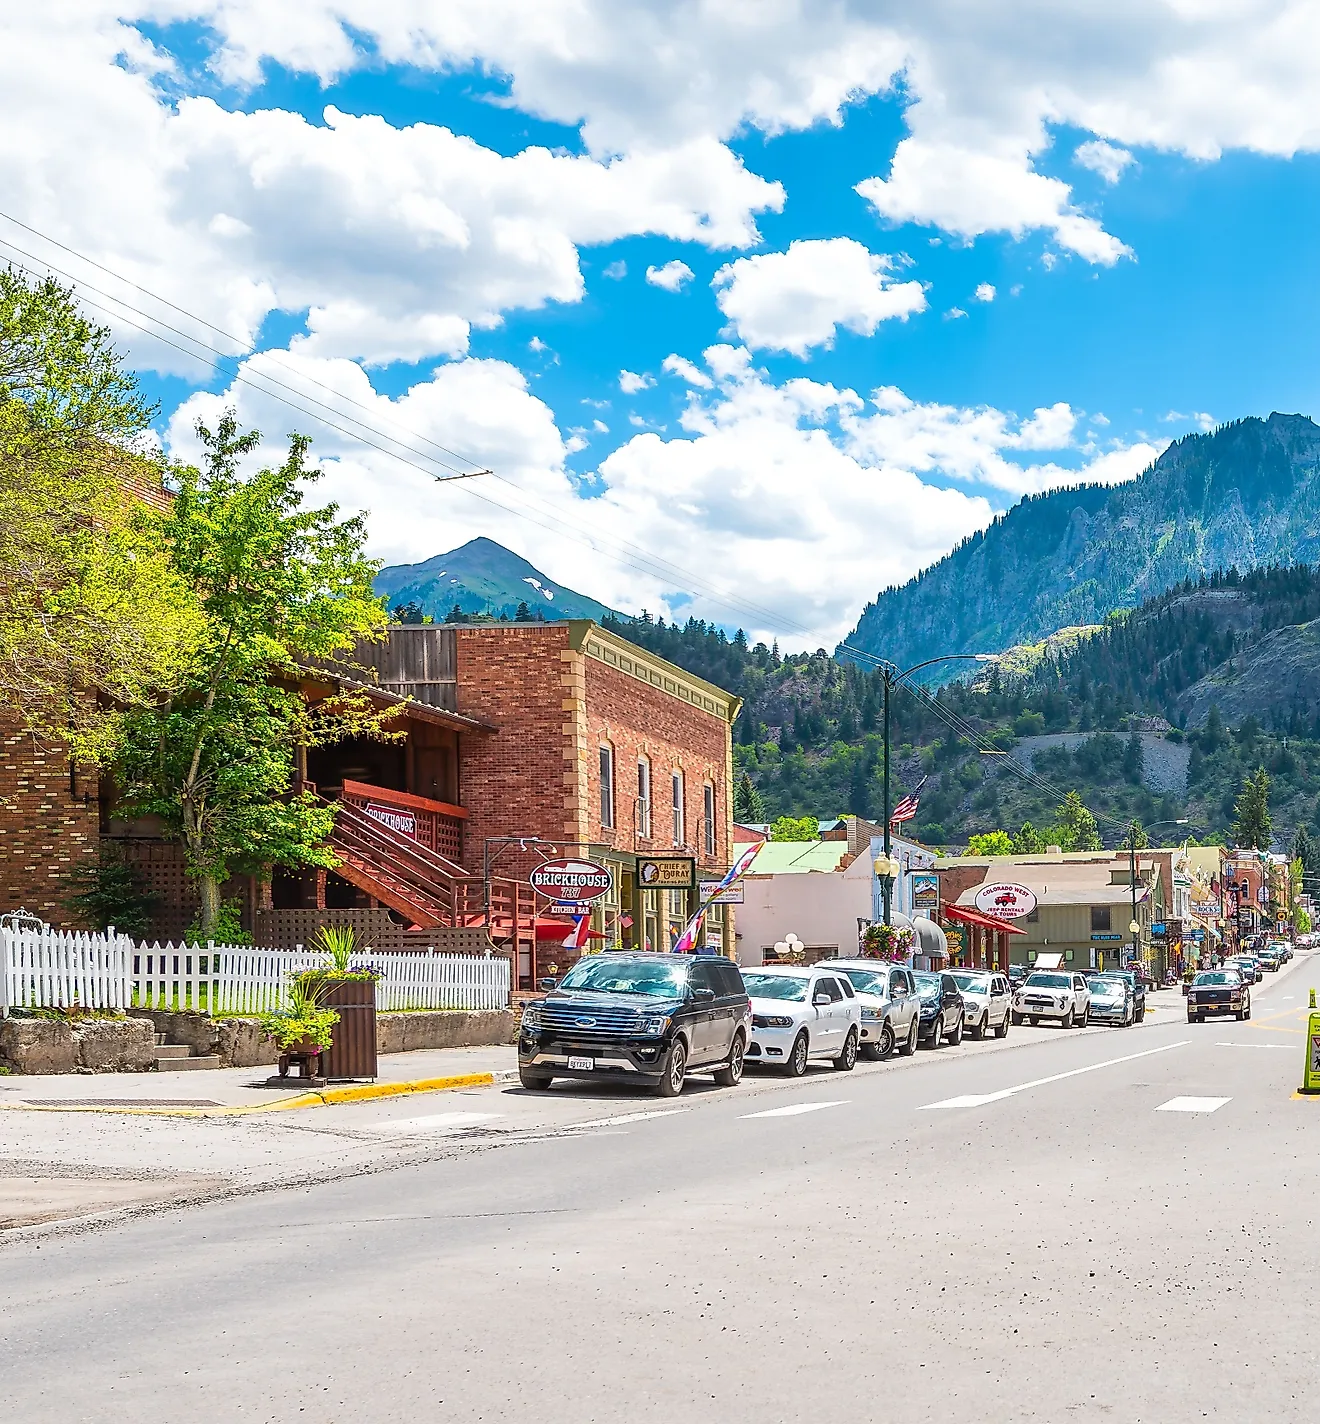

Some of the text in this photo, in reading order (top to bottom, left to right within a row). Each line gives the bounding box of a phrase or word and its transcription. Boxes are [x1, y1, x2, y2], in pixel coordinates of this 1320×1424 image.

[535, 873, 608, 887] BRICKHOUSE
[561, 887, 581, 898] 737
[982, 886, 1030, 897] COLORADO WEST
